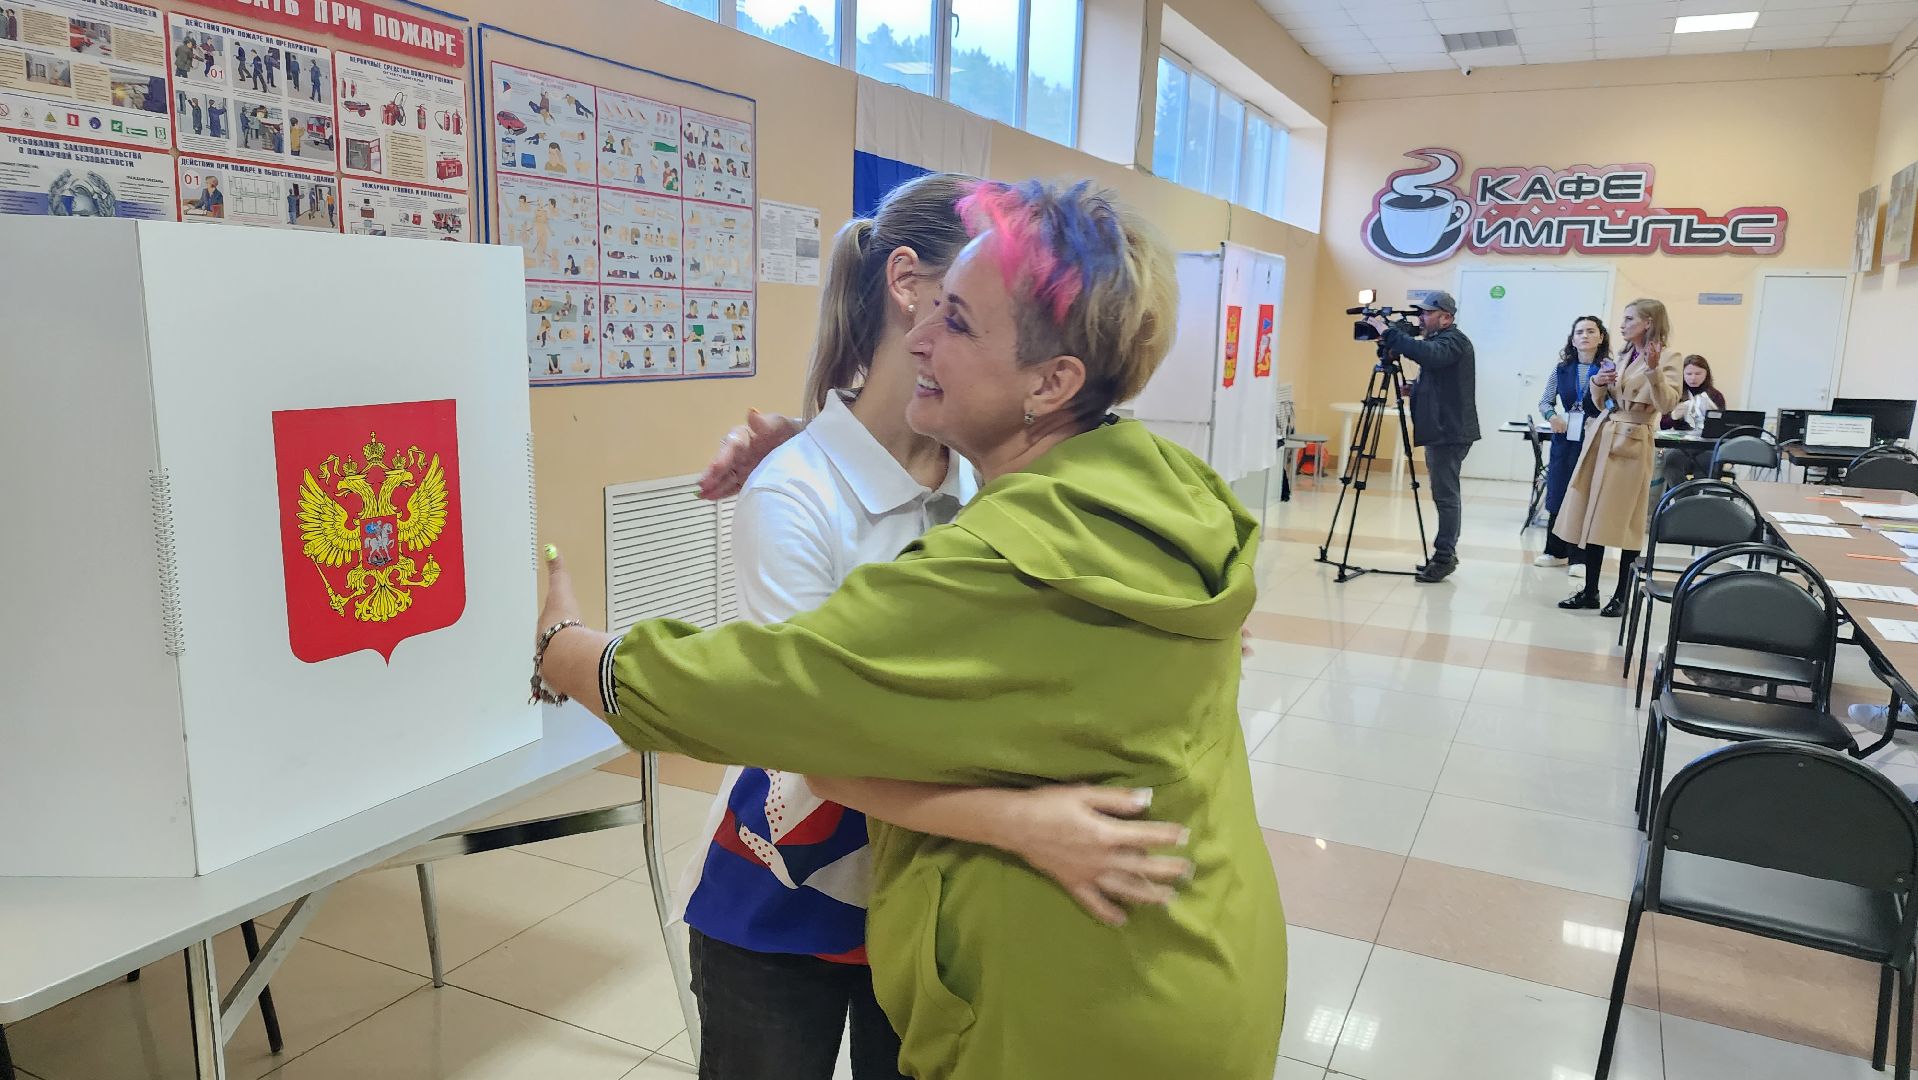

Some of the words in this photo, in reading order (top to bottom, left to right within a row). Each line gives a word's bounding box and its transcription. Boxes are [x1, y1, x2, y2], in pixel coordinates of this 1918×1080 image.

[184, 18, 221, 33] ДЕЙСТВИЯ
[222, 26, 236, 37] ПРИ
[237, 30, 264, 43] ПОЖАРЕ
[265, 36, 274, 45] НА
[314, 0, 362, 31] ПРИ
[373, 13, 457, 57] ПОЖАРЕ
[209, 67, 225, 80] 01
[7, 135, 61, 150] ТРЕБОВАНИЯ
[62, 142, 143, 160] ЗАКОНОДАТЕЛЬСТВА
[26, 147, 73, 160] ПОЖАРНОЙ
[74, 154, 135, 168] БЕЗОПАСНОСТИ
[181, 157, 215, 169] ДЕЙСТВИЯ
[216, 163, 230, 171] ПРИ
[231, 164, 257, 174] ПОЖАРЕ
[184, 173, 200, 186] 01
[1478, 171, 1646, 204] КАФЕ
[1473, 215, 1778, 246] ИМПУЛЬС
